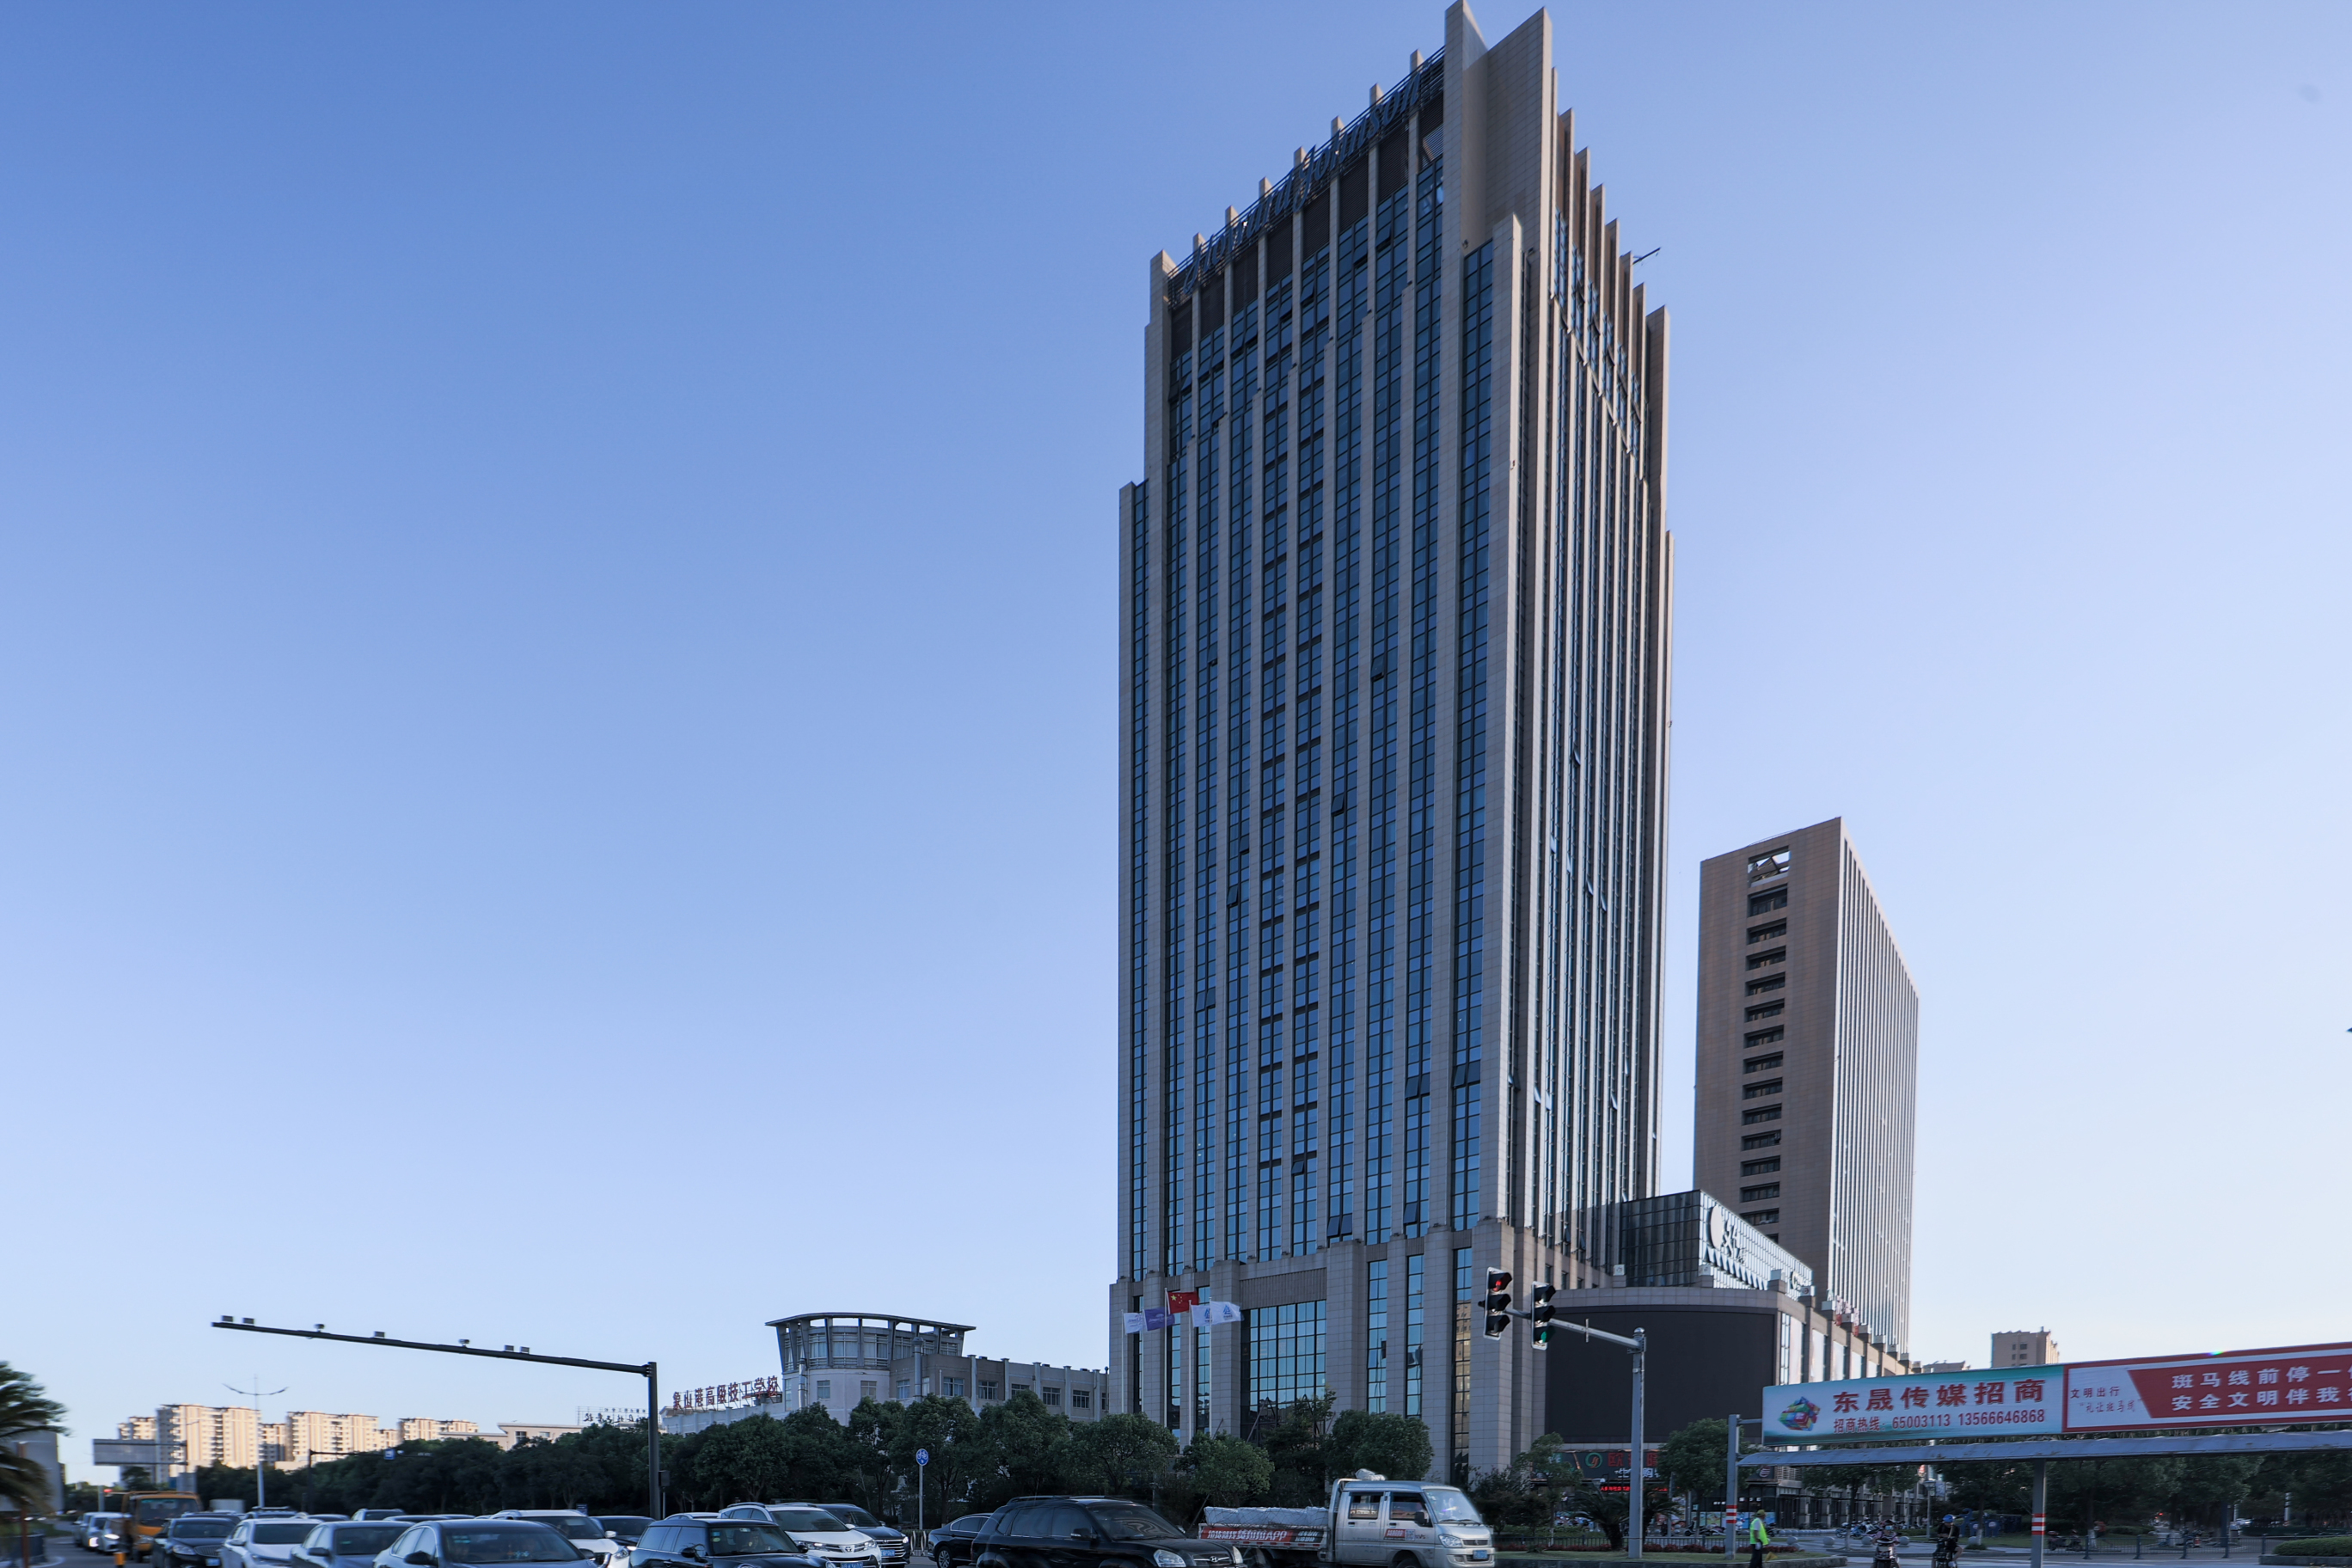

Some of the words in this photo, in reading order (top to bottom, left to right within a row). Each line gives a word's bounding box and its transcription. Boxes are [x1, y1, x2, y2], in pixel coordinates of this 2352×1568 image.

[1292, 72, 1421, 213] Johnson
[1833, 1379, 2046, 1413] 东晟传媒招商
[2070, 1386, 2120, 1399] 文明出行
[1892, 1413, 1951, 1430] 65003113
[1957, 1409, 2045, 1426] 13566646868
